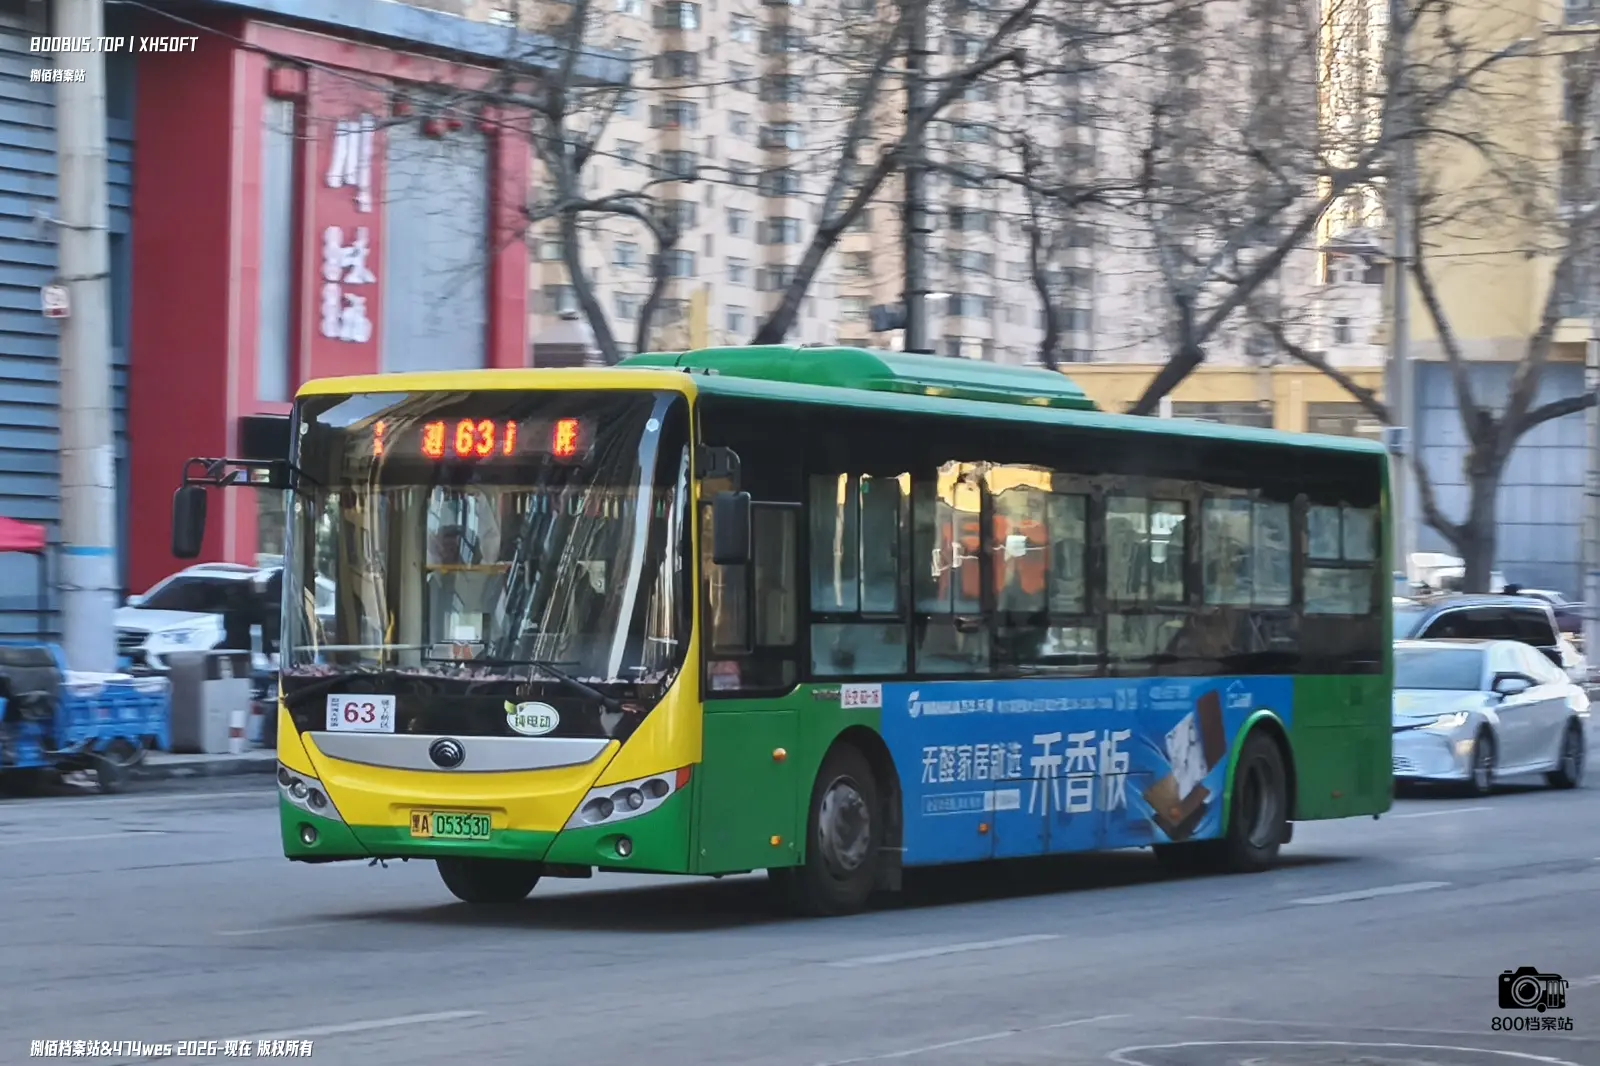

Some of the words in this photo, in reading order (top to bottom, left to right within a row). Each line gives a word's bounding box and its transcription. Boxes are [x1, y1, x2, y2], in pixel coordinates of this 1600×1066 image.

[344, 702, 376, 723] 63
[515, 714, 551, 728] 纯电动
[1028, 728, 1132, 816] 禾香板
